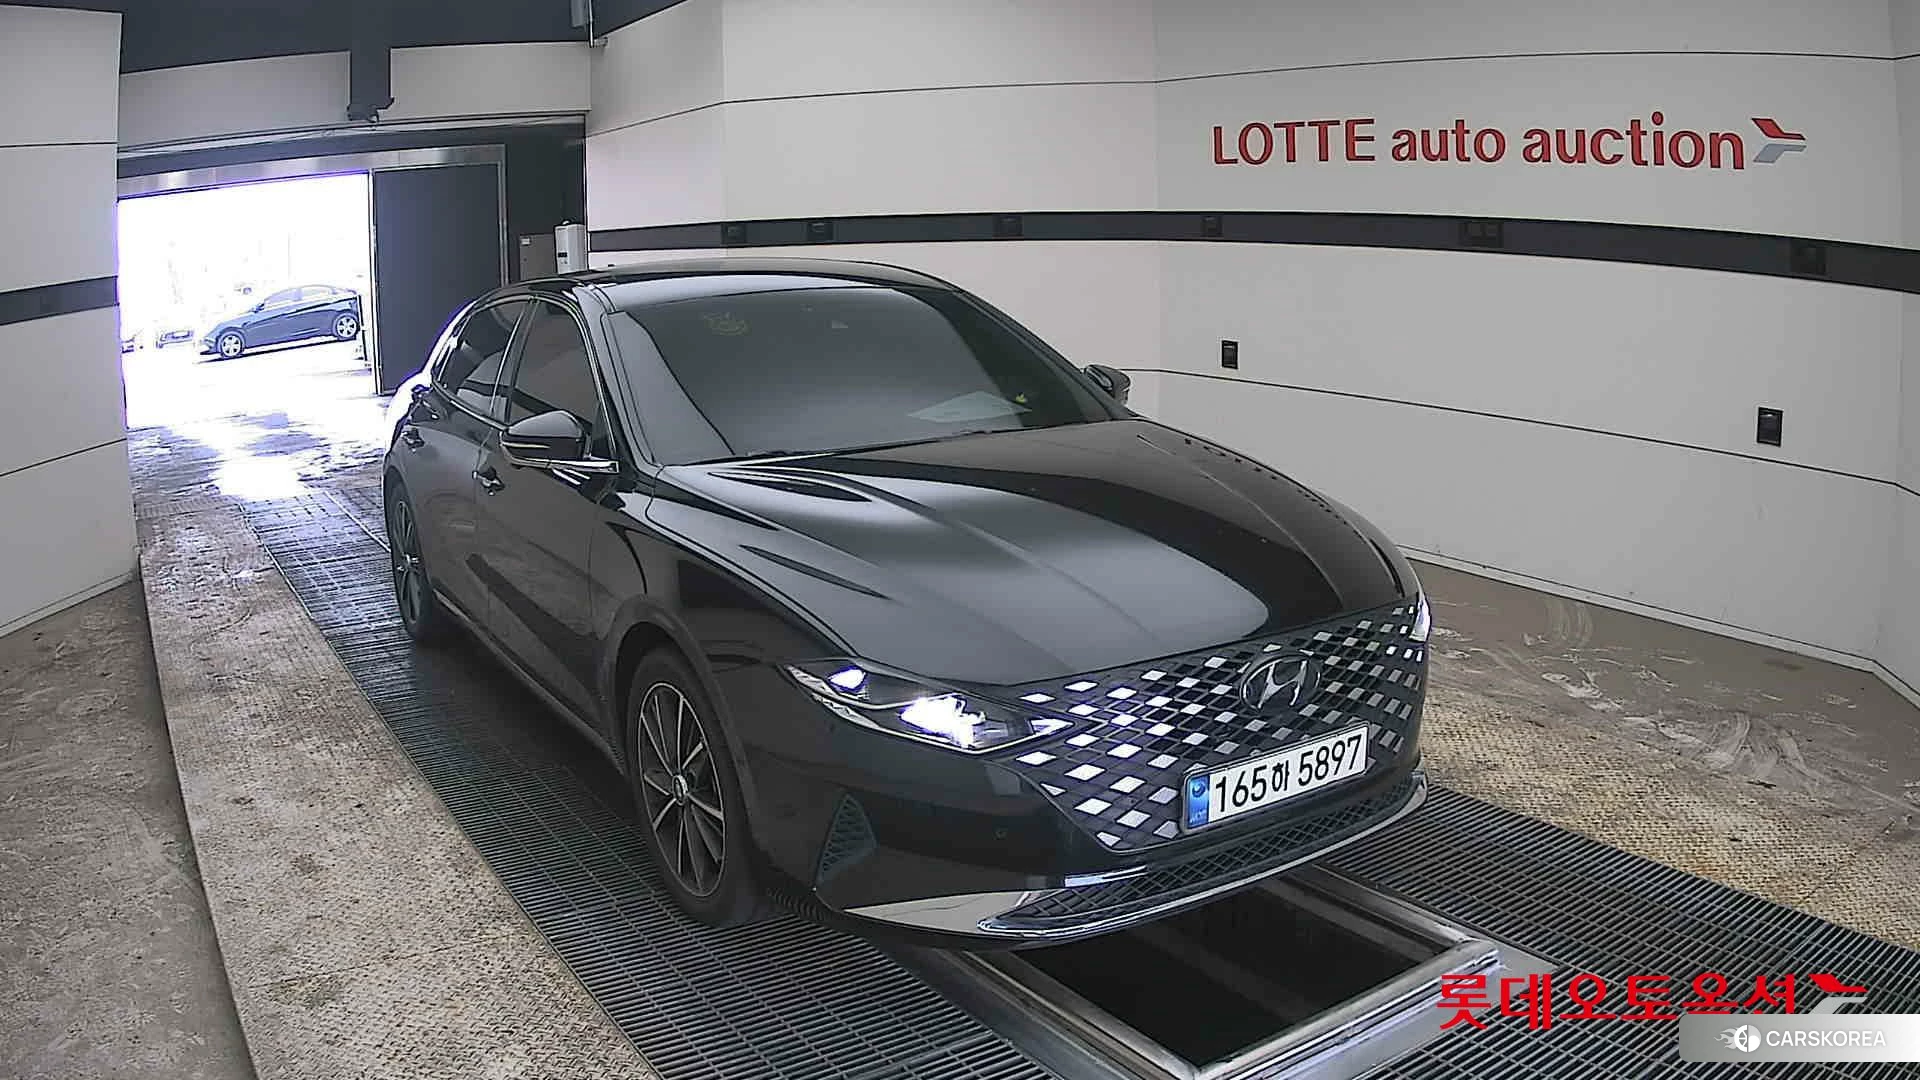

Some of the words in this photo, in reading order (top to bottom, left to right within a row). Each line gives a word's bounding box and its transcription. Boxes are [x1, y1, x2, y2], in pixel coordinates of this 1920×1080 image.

[1212, 118, 1376, 164] LOTTE
[1391, 119, 1506, 162] auto
[1522, 111, 1745, 170] auction
[1215, 760, 1290, 813] 165하
[1298, 734, 1363, 786] 5897
